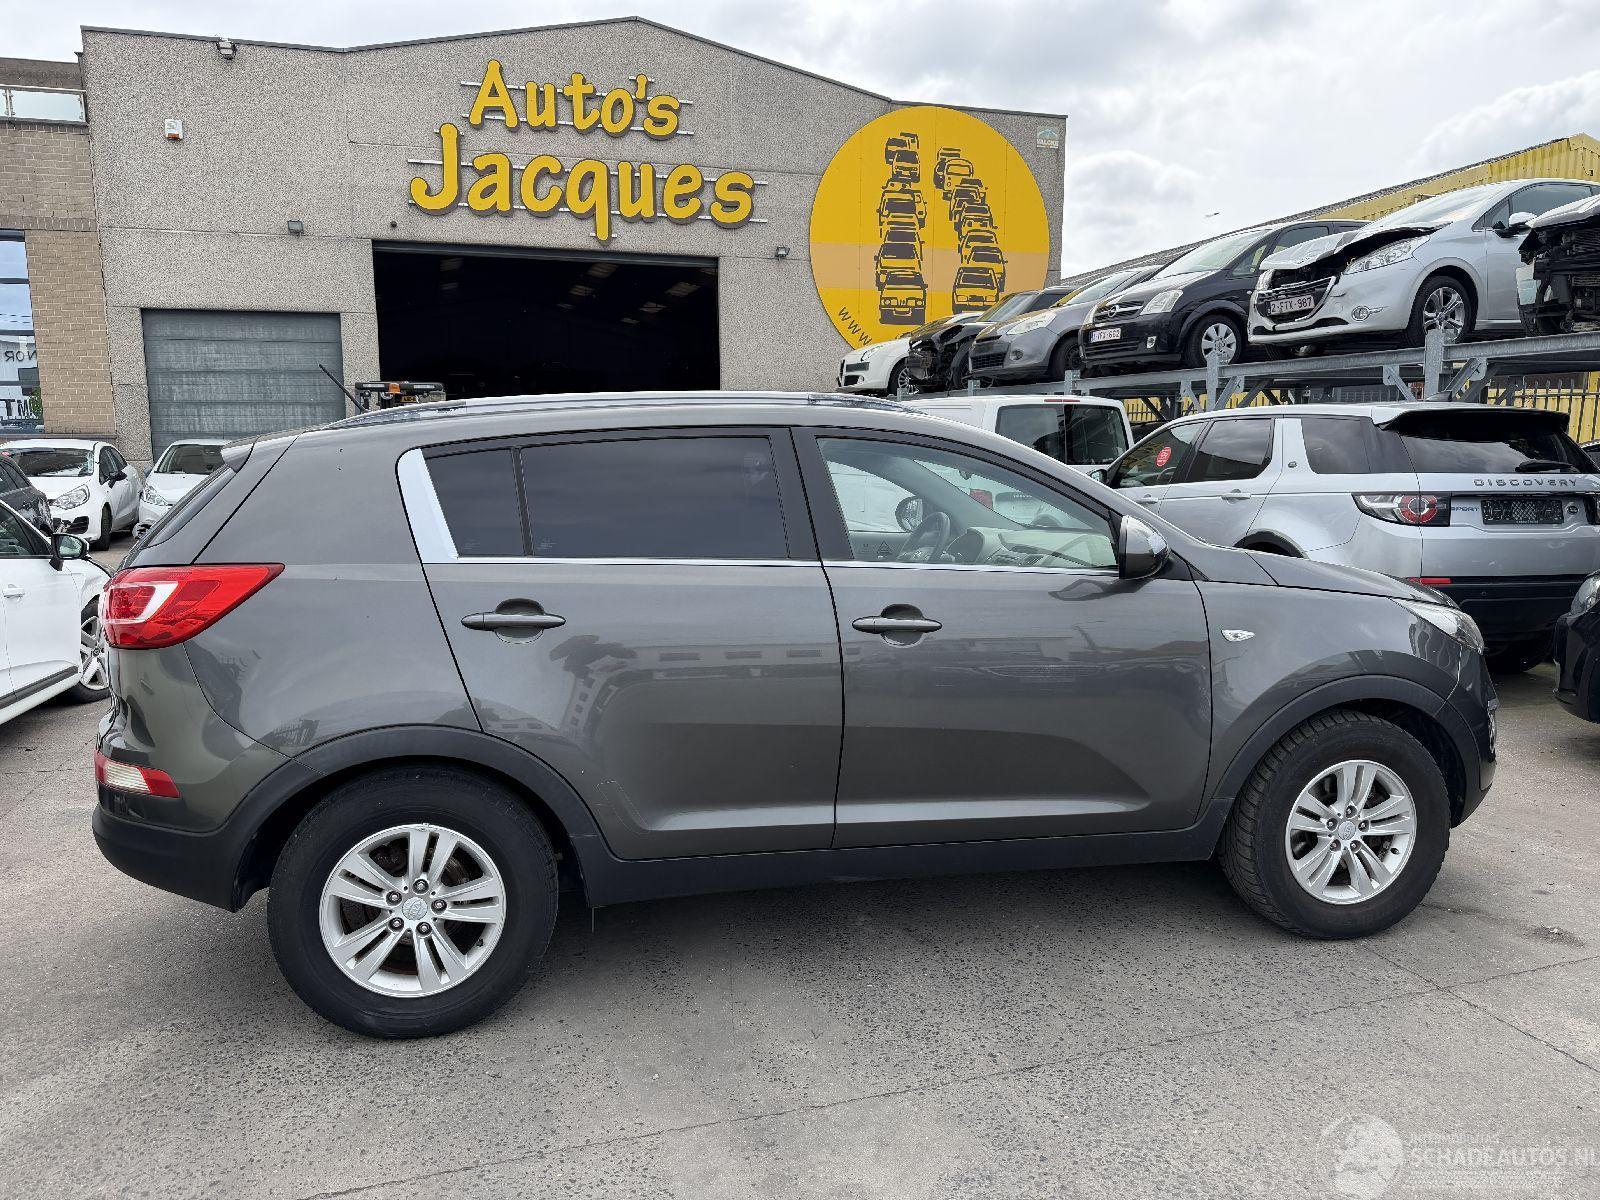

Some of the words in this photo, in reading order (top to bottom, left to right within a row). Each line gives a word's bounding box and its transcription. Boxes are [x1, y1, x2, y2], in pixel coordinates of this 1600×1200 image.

[469, 59, 681, 140] Auto's
[410, 123, 754, 242] Jacques
[1473, 478, 1577, 487] DISCOVERY
